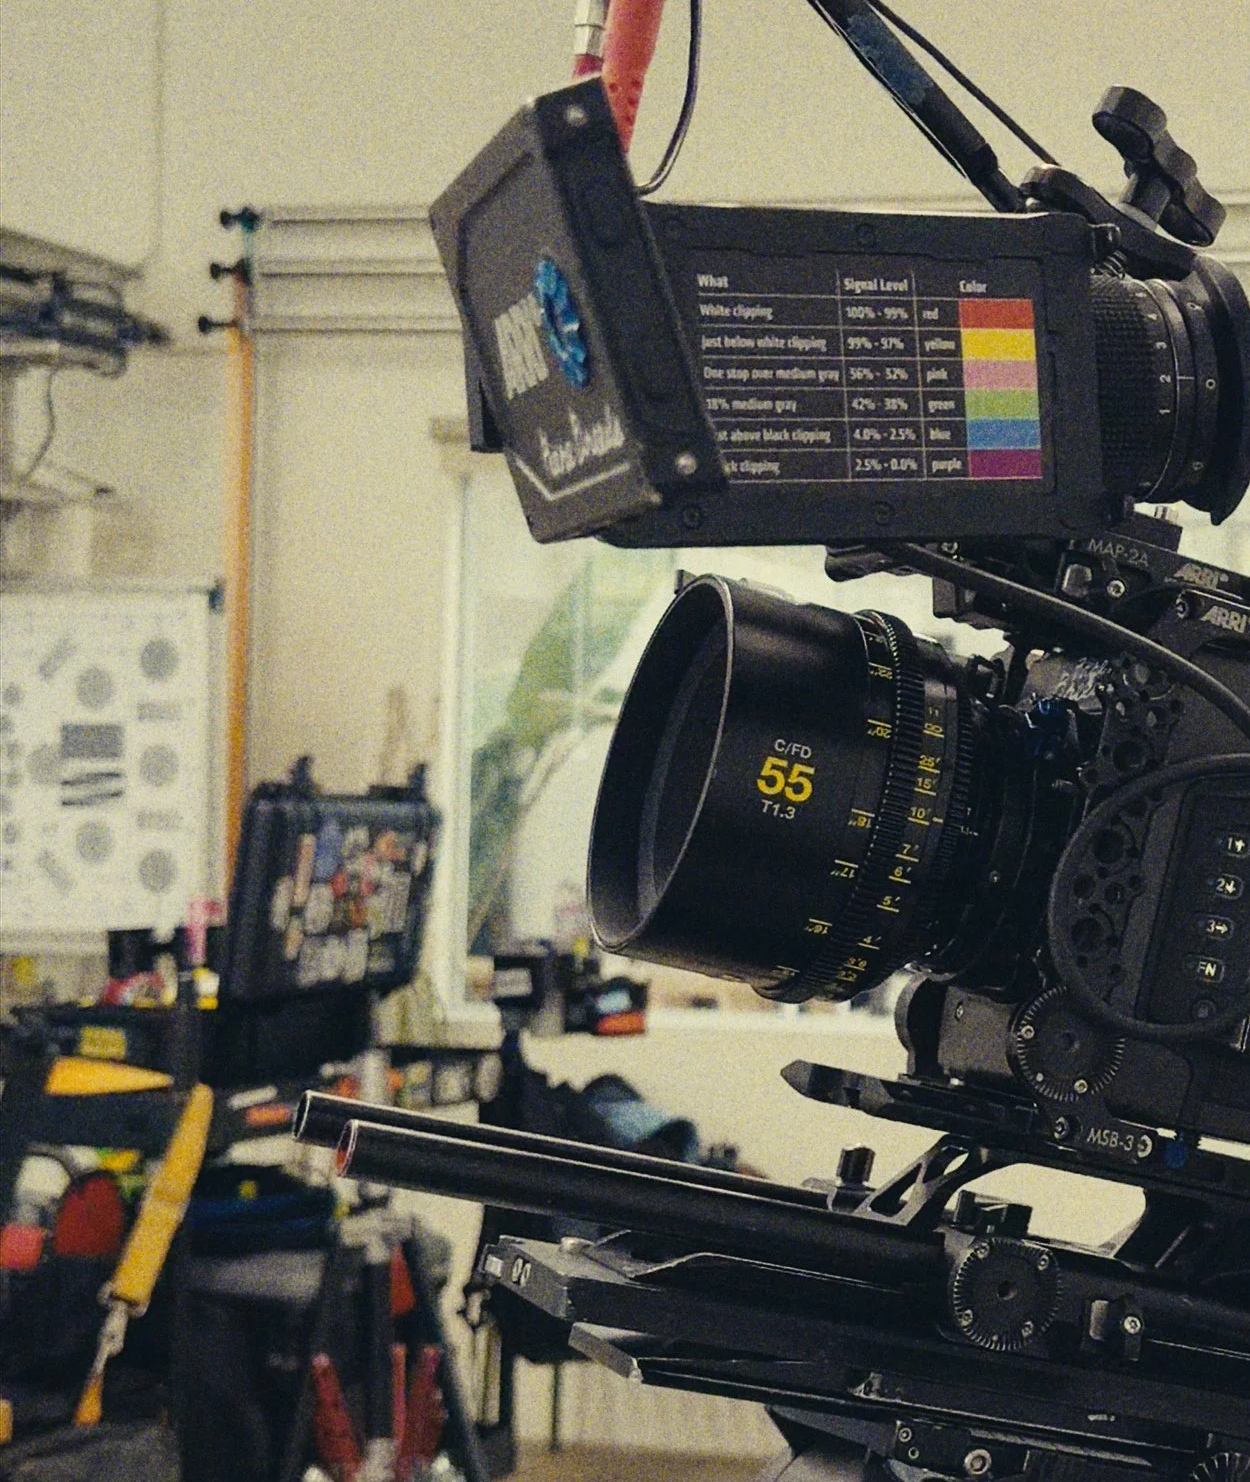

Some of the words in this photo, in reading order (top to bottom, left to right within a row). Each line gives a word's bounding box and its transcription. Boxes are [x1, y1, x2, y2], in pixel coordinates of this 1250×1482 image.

[697, 274, 728, 288] What
[844, 277, 878, 294] Signal
[880, 278, 908, 292] Level
[959, 280, 987, 293] Color
[700, 304, 730, 316] White
[733, 303, 773, 320] clipping
[845, 306, 875, 319] 100%
[922, 307, 939, 320] red
[724, 335, 755, 348] below
[757, 335, 785, 348] white
[788, 335, 827, 352] clipping
[880, 337, 905, 350] 97%
[924, 338, 956, 352] yellow
[704, 367, 724, 379] One
[726, 368, 750, 382] stop
[751, 369, 773, 379] over
[776, 367, 816, 379] medium
[926, 368, 948, 383] pink
[1159, 374, 1171, 384] 2
[706, 398, 730, 410] 18%
[732, 398, 773, 410] medium
[852, 398, 876, 411] 42%
[928, 400, 956, 413] green
[730, 429, 761, 441] above
[763, 428, 790, 441] black
[792, 429, 831, 444] clipping
[853, 428, 882, 441] 4.0%
[889, 428, 916, 441] 2.5%
[929, 427, 951, 440] blue
[739, 460, 781, 475] clipping
[855, 458, 882, 471] 2.5%
[890, 458, 918, 471] 0.0%
[932, 457, 962, 473] purple
[1173, 562, 1219, 589] ARRI
[1201, 605, 1246, 633] ARRI
[774, 739, 812, 759] C/FD
[757, 756, 815, 803] 55
[761, 799, 796, 820] T1.3
[1216, 878, 1225, 892] 2
[1207, 920, 1216, 933] 3
[1198, 960, 1217, 977] FN
[1086, 1127, 1134, 1151] MSB-3
